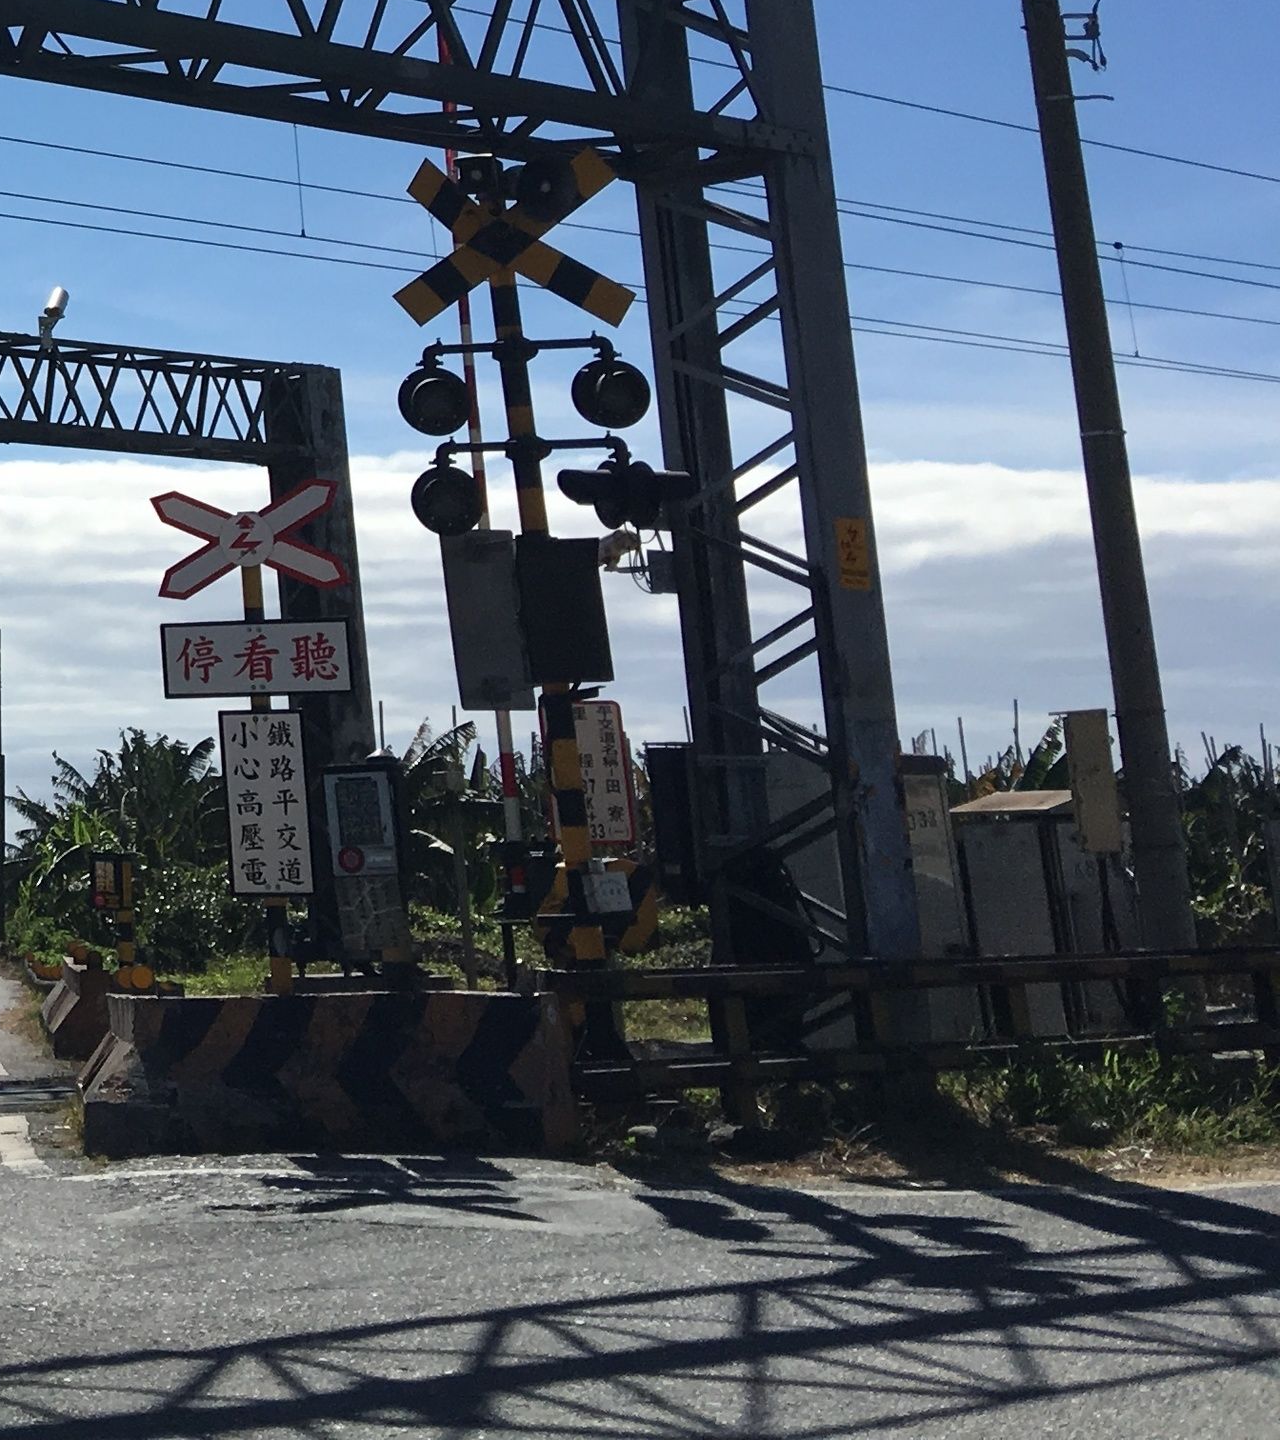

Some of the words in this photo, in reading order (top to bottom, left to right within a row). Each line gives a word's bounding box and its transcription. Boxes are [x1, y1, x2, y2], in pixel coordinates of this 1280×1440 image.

[176, 632, 341, 684] 停看聽
[231, 721, 268, 886] 小心高壓電
[267, 720, 305, 886] 鐵路平交道
